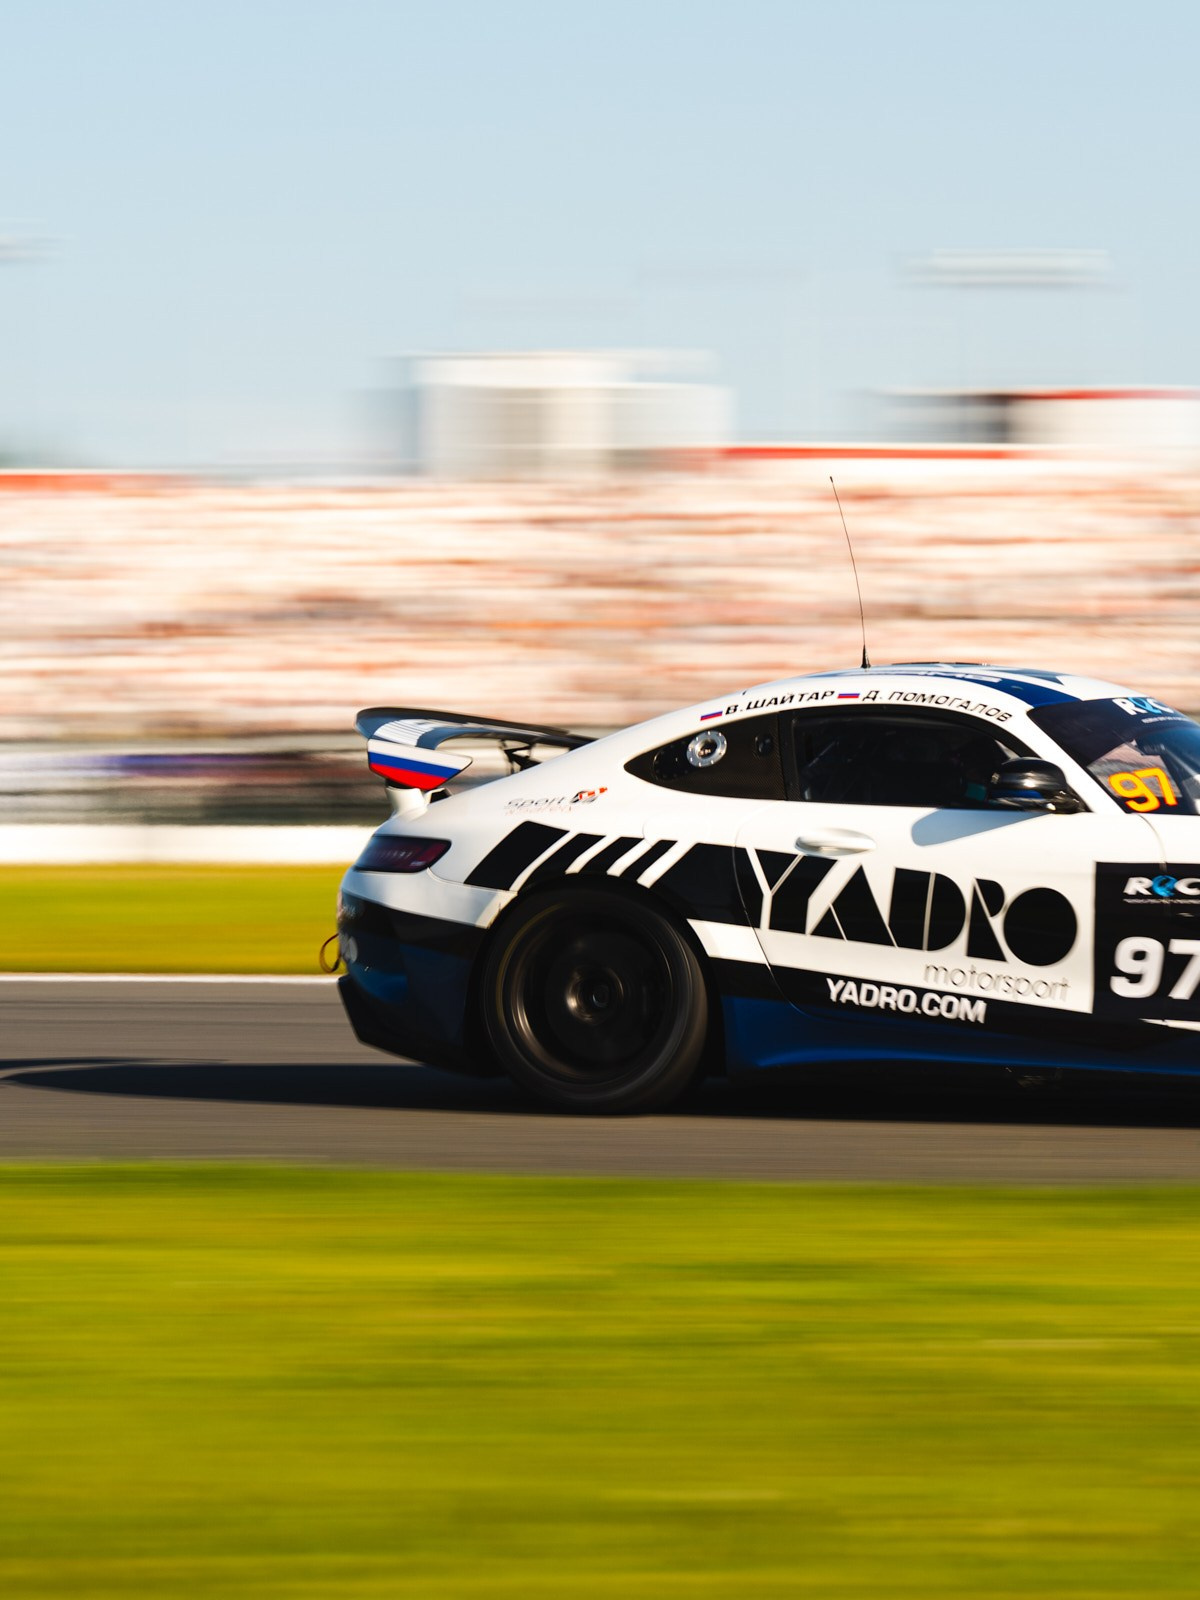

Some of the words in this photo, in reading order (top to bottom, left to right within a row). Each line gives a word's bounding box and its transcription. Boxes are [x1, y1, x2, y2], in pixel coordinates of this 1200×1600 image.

[1108, 767, 1178, 813] 97
[754, 848, 1078, 967] YADRO
[826, 978, 987, 1024] YADRO.COM
[923, 963, 1071, 1002] motorsport
